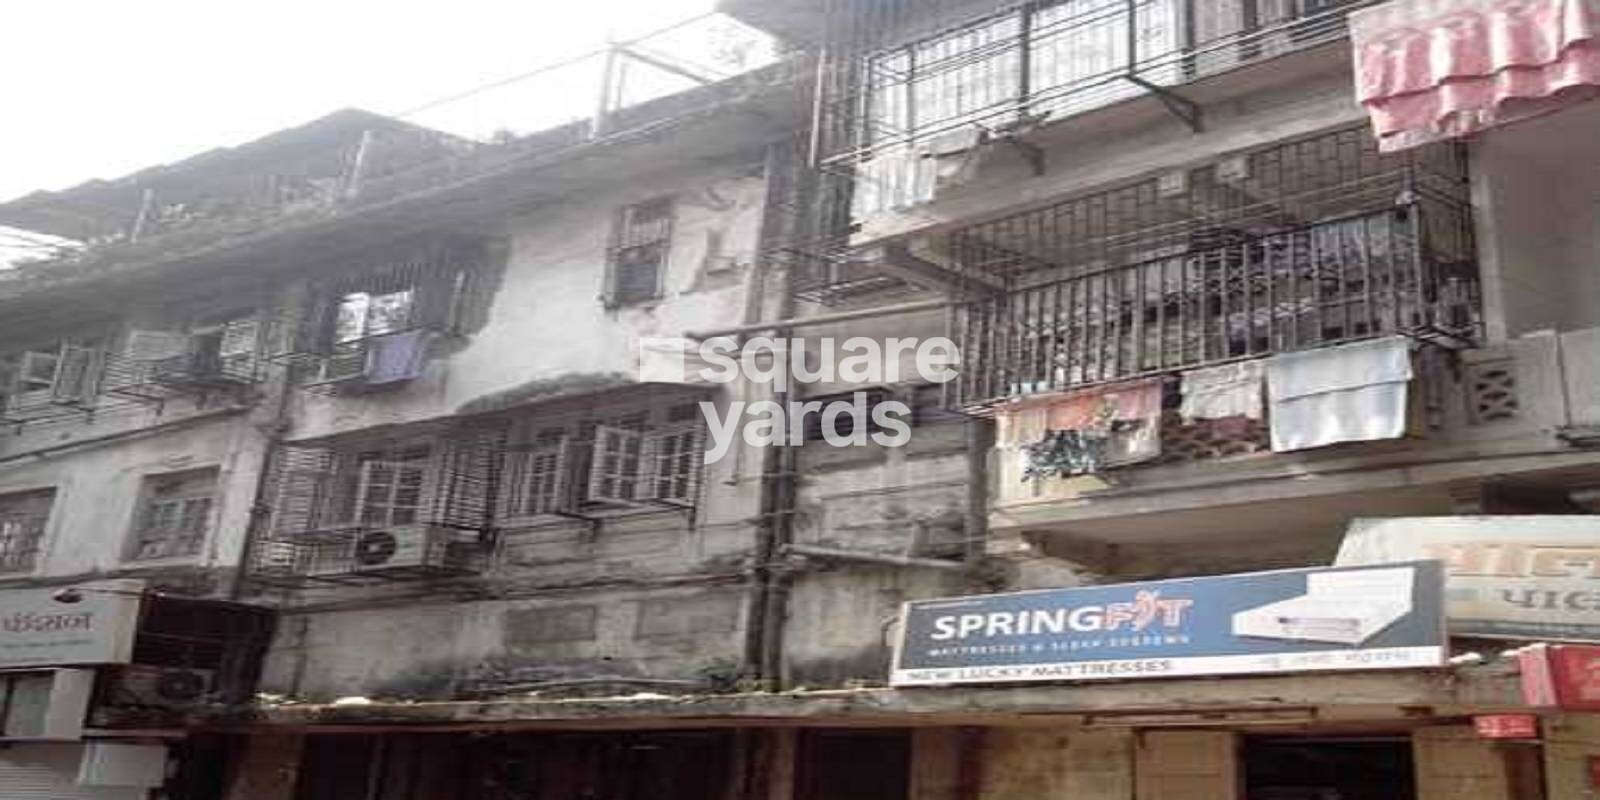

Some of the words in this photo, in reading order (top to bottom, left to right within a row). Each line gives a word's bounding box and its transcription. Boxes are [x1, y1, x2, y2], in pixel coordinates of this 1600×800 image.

[930, 590, 1194, 640] SPRINGFIT
[908, 670, 951, 683] NEW
[959, 666, 1025, 681] LUCKY
[1031, 659, 1174, 678] MATTRESSES
